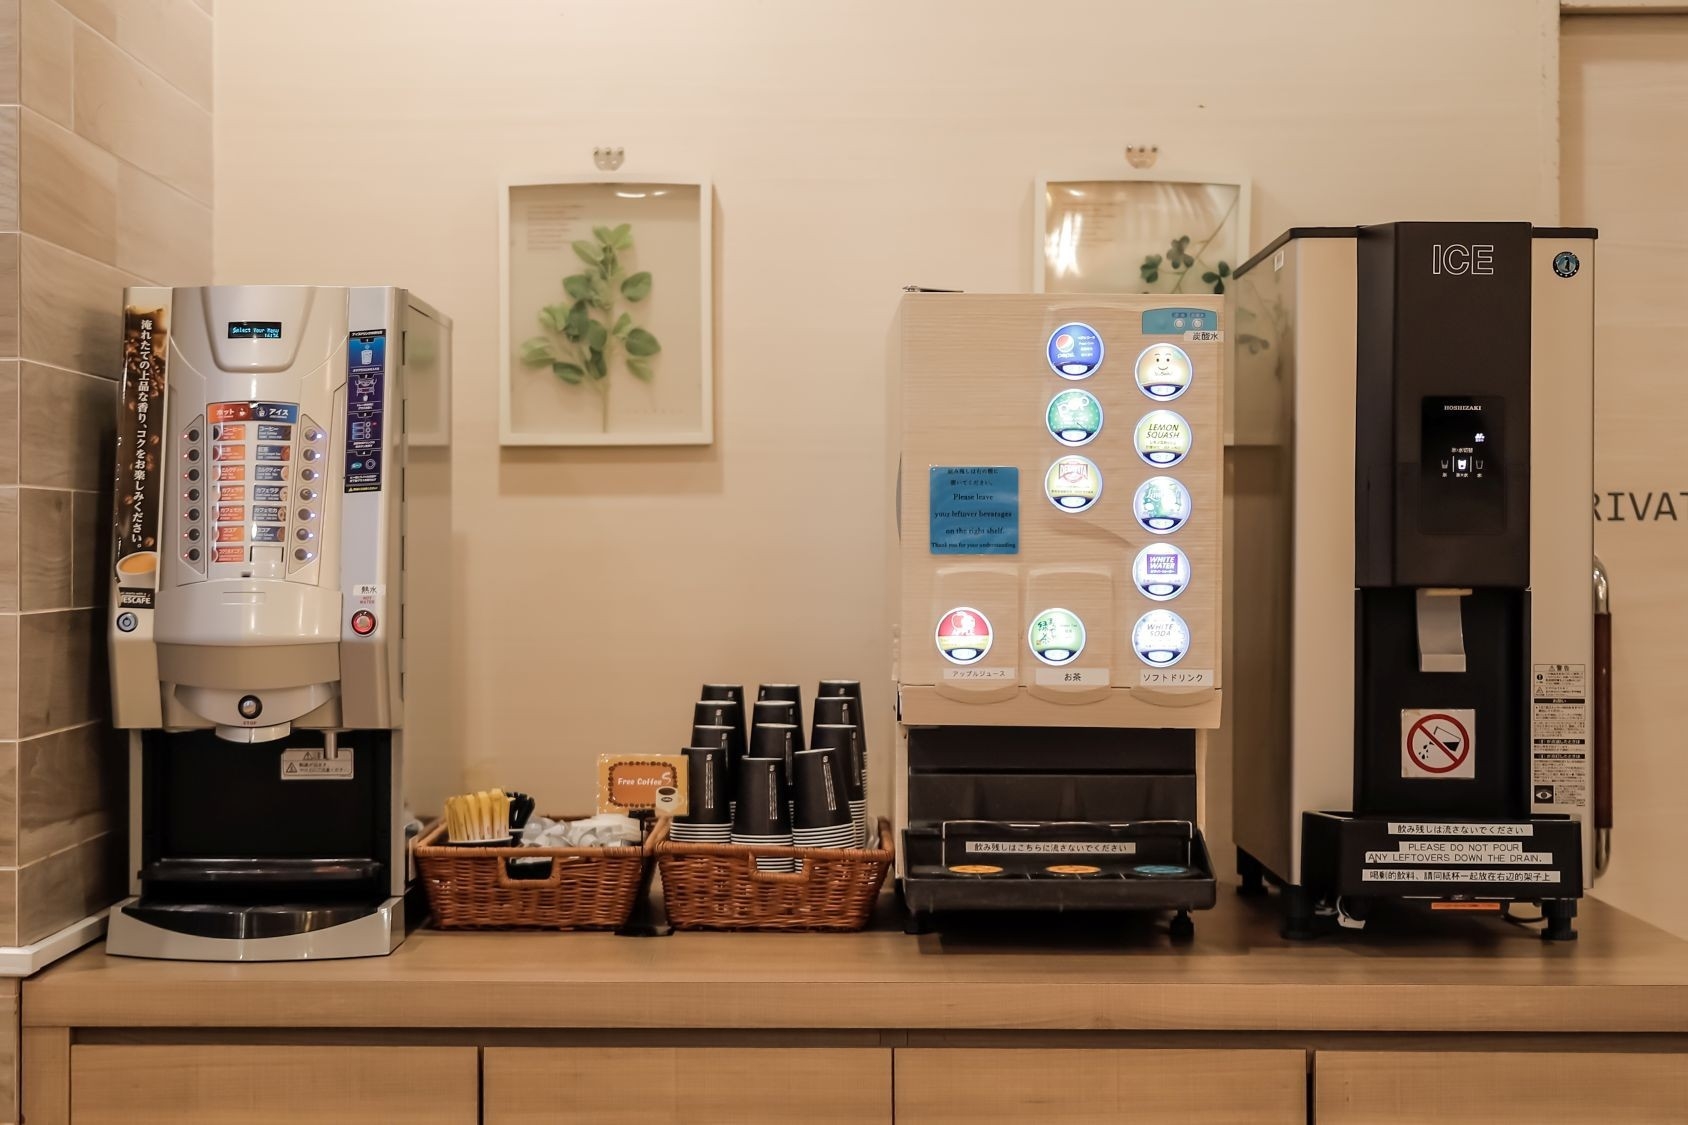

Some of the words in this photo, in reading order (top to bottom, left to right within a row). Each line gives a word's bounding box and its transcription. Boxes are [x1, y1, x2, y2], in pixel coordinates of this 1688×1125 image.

[1433, 244, 1494, 275] ICE
[1192, 332, 1218, 341] 炭酸水
[216, 408, 234, 416] ホット
[269, 408, 288, 416] アイス
[1148, 424, 1179, 432] LEMON
[1146, 431, 1180, 439] SQUASH
[953, 493, 974, 501] Please
[952, 510, 977, 518] leftover
[968, 528, 984, 536] right
[1064, 672, 1082, 682] お茶
[1144, 674, 1203, 683] ソフトドリンク
[638, 778, 662, 786] Coffee
[1397, 824, 1524, 835] 飲み残しは流さないでください
[974, 842, 1127, 853] 飲み残しはこちらに流さないでください
[1408, 844, 1446, 852] PLEASE
[1450, 844, 1464, 852] DO
[1468, 844, 1488, 852] NOT
[1493, 844, 1520, 852] POUR
[1392, 854, 1450, 862] LEFTOVERS
[1454, 854, 1482, 862] DOWN
[1488, 854, 1506, 862] THE
[1510, 854, 1542, 862] DRAIN.
